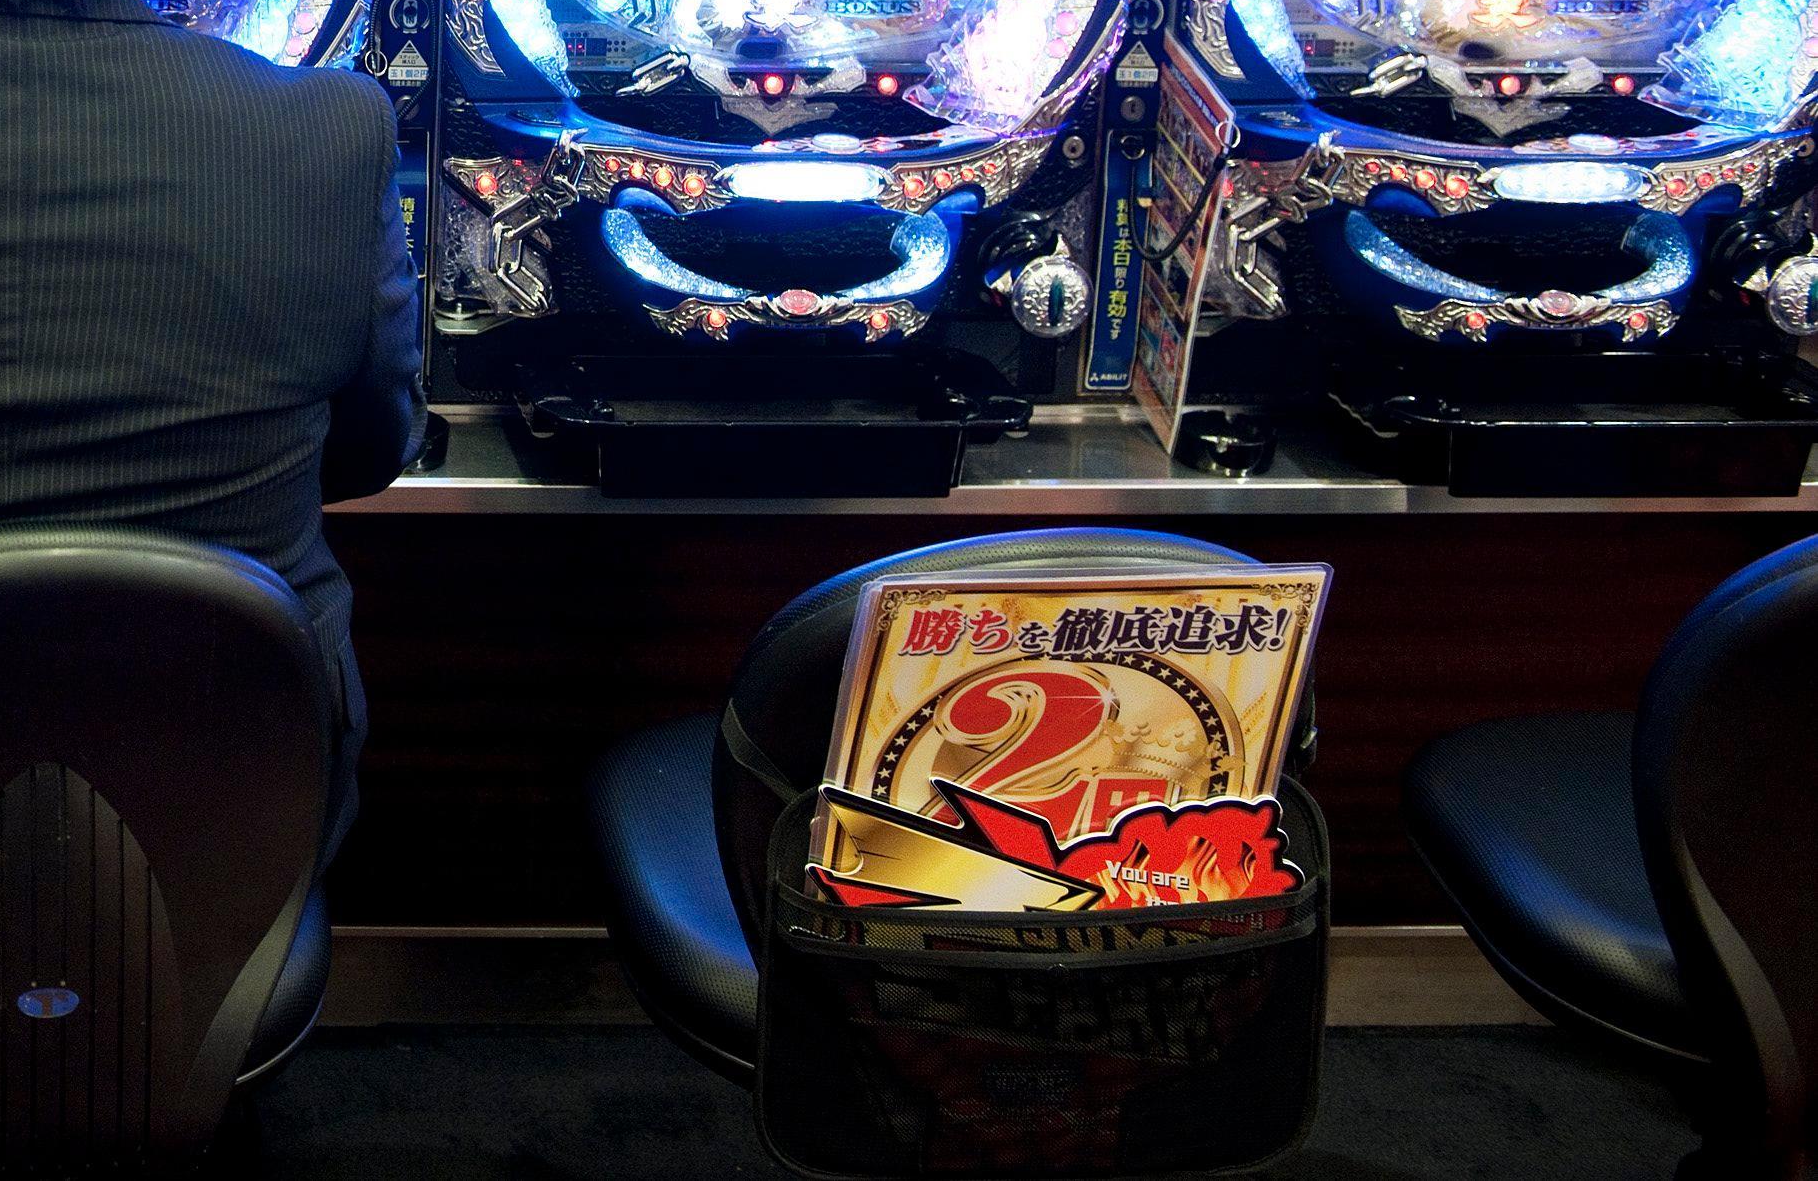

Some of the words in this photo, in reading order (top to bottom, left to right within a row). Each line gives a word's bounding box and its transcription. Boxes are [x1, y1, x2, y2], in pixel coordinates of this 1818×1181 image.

[899, 607, 1293, 656] 勝ちを徹底追求!
[1106, 860, 1150, 885] You
[1152, 869, 1191, 891] are
